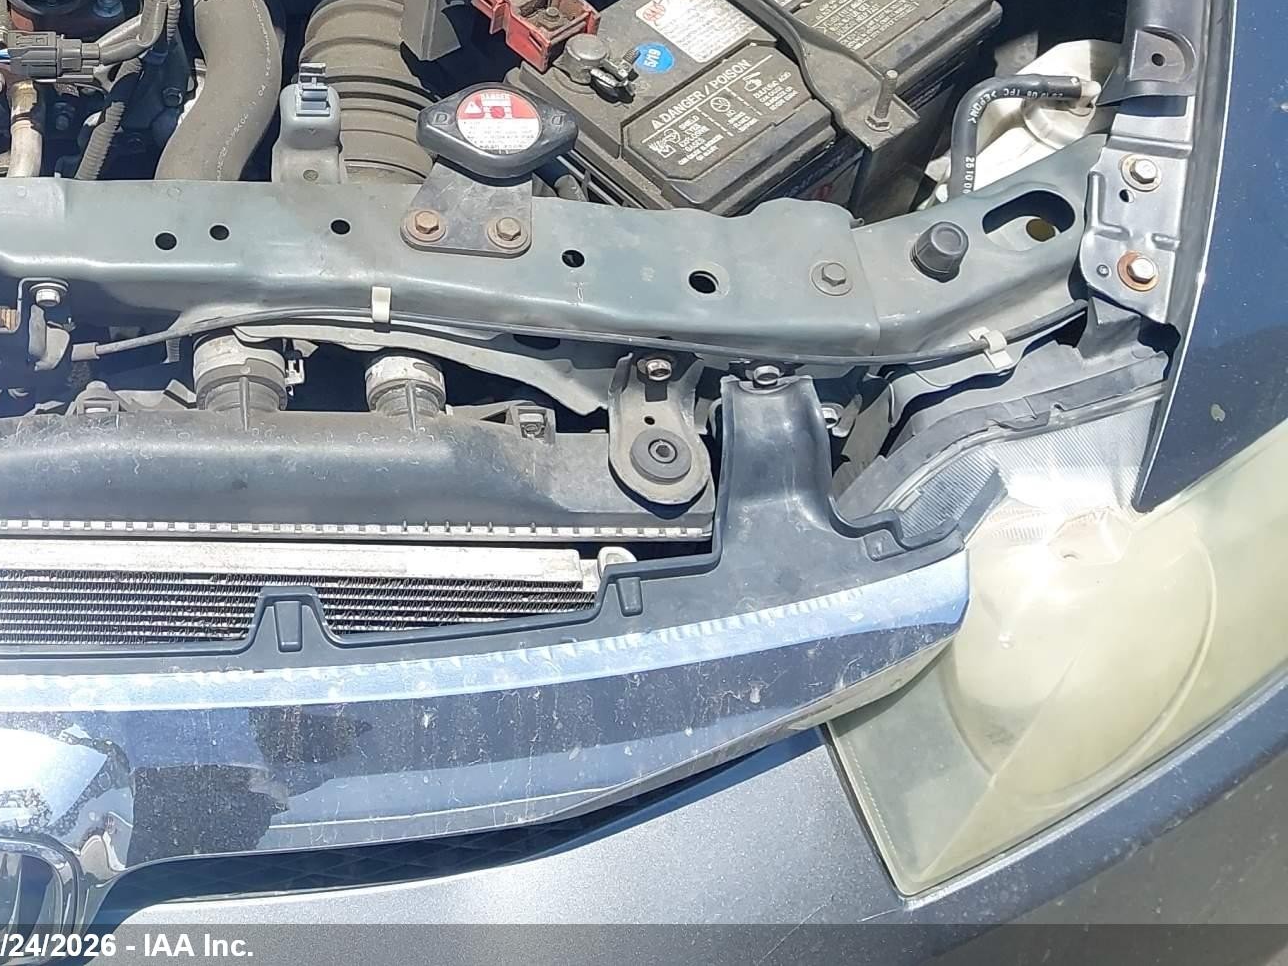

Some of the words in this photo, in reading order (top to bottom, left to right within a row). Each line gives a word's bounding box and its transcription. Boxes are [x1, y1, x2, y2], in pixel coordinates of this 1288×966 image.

[643, 48, 662, 68] 5/19
[658, 90, 706, 124] DANGER
[708, 58, 752, 90] POISON
